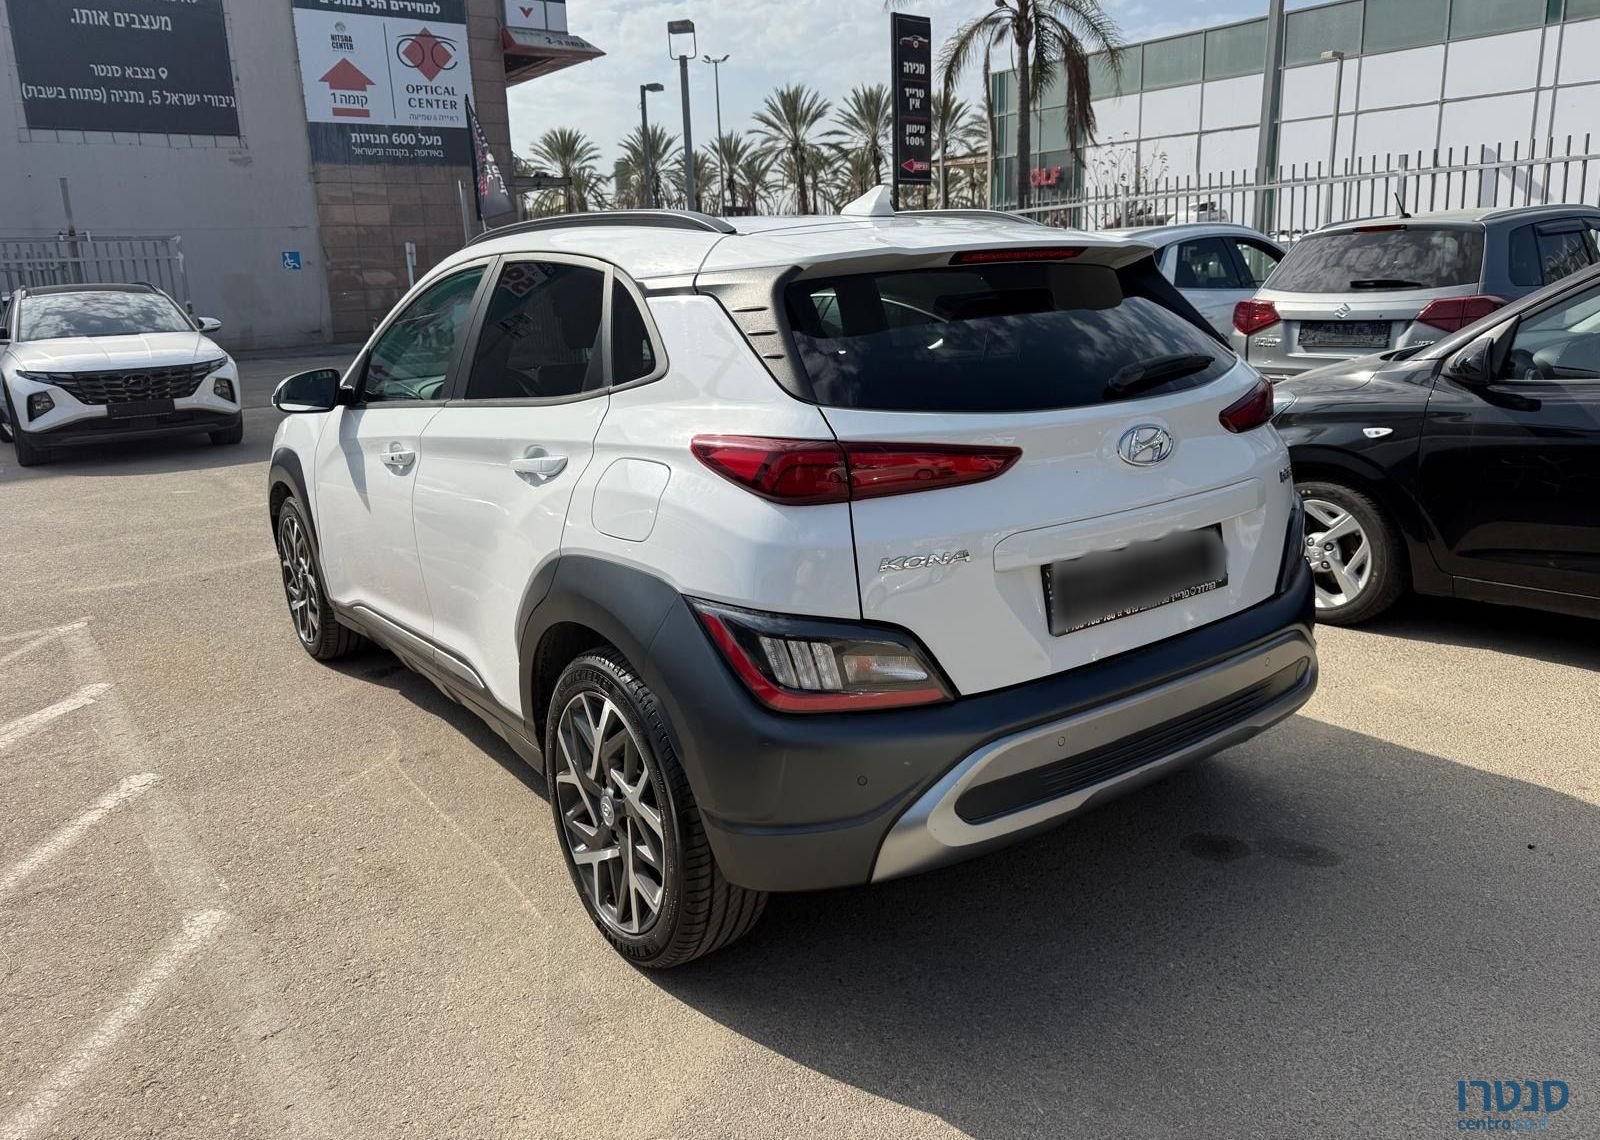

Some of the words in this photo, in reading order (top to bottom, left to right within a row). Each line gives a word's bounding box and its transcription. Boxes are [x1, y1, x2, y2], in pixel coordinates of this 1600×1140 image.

[390, 0, 441, 15] למחירים
[70, 8, 111, 27] אותו.
[113, 12, 173, 32] מעצבים
[331, 42, 354, 51] CENTER
[89, 63, 121, 78] סנטר
[124, 65, 156, 80] נצבא
[903, 61, 926, 75] מכירה
[21, 83, 67, 99] בשבת)
[69, 86, 108, 104] (פתוח
[109, 88, 144, 104] נתניה
[405, 84, 458, 97] OPTICAL
[904, 87, 925, 99] טרייד
[163, 89, 201, 106] ישראל
[203, 94, 236, 108] גיבורי
[330, 92, 337, 104] 1
[340, 93, 368, 108] קומה
[407, 98, 457, 110] CENTER
[909, 98, 921, 111] אין
[409, 113, 433, 121] שמיעה
[905, 124, 926, 136] מימון
[351, 132, 389, 144] חנויות
[391, 132, 416, 145] 600
[418, 133, 442, 146] מעל
[905, 136, 925, 147] 100%
[351, 146, 384, 157] ובישראל
[385, 147, 409, 159] בקנדה
[1029, 166, 1061, 187] OLF
[879, 549, 971, 573] KONA
